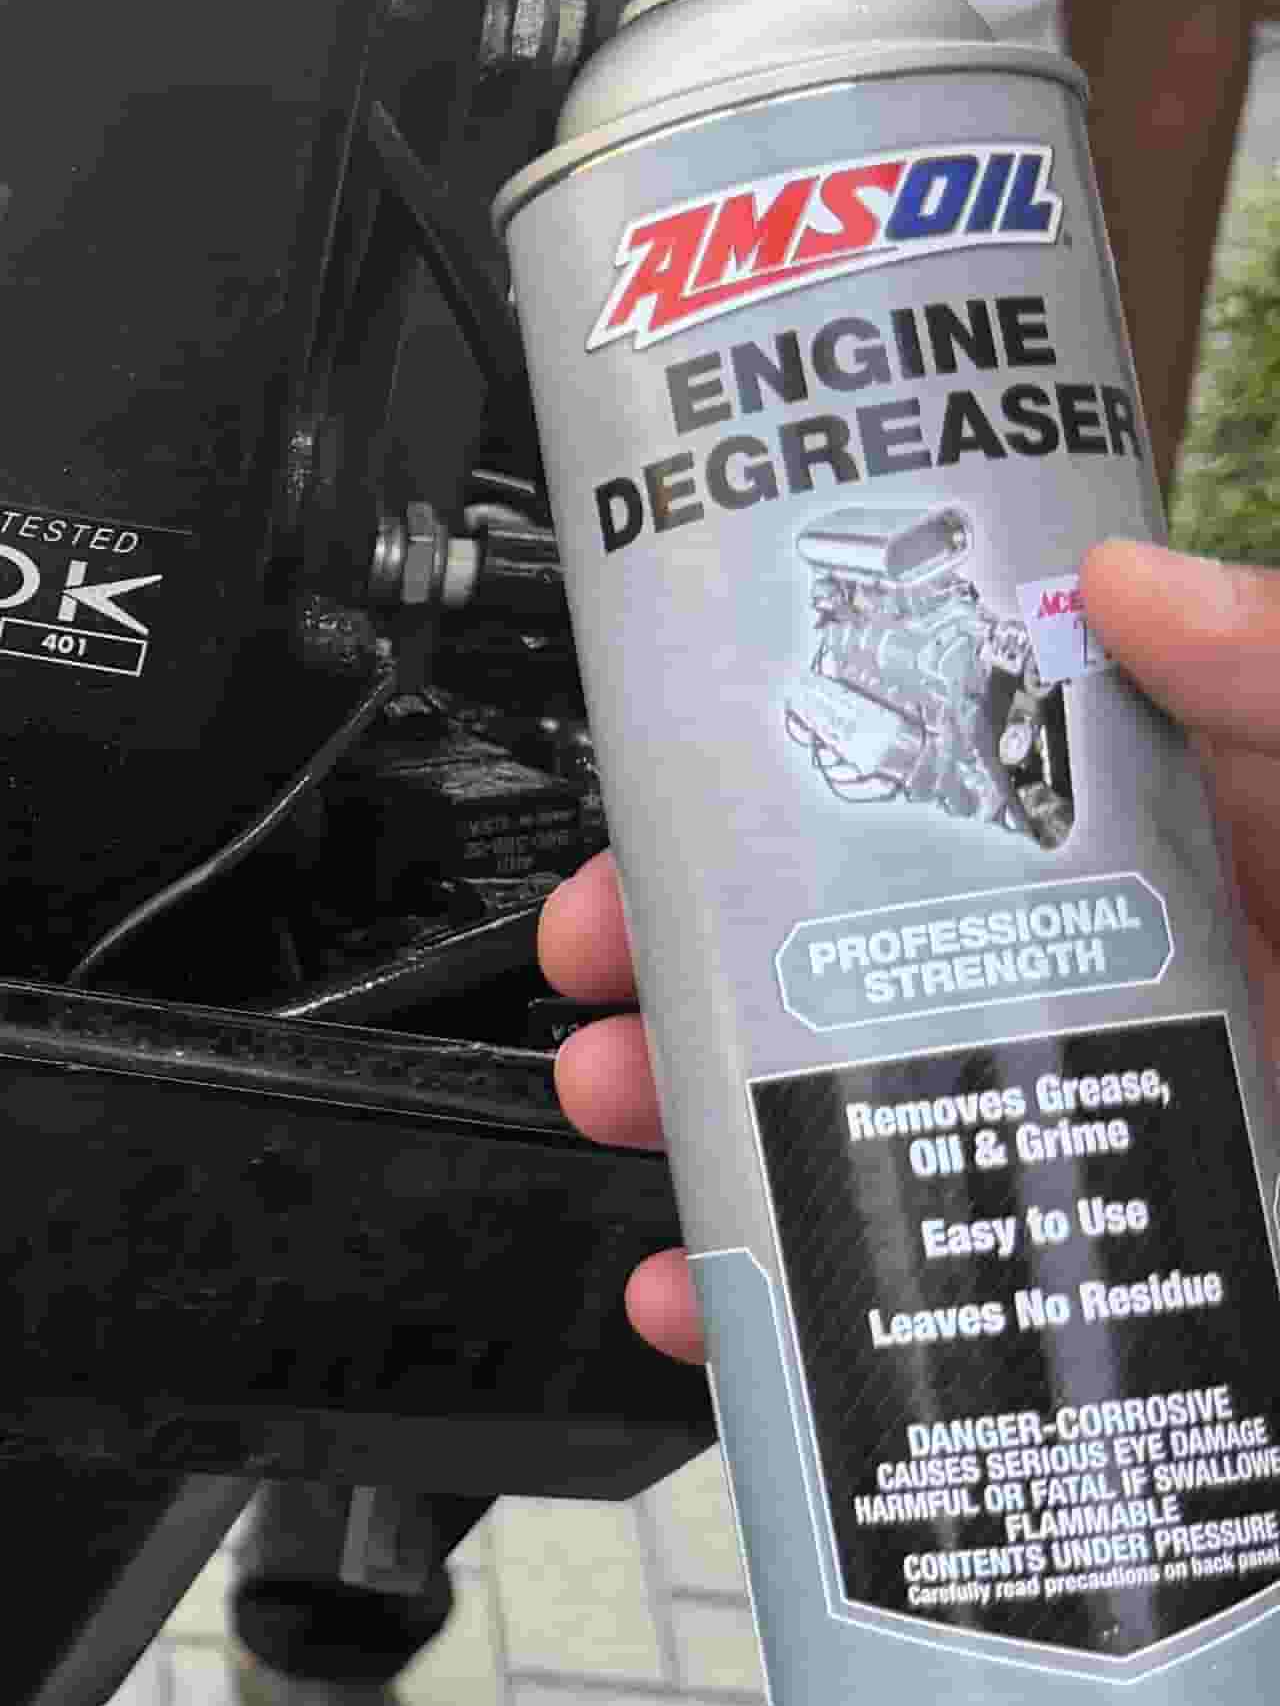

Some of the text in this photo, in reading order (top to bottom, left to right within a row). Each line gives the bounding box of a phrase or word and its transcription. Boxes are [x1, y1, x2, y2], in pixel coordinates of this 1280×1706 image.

[606, 151, 1060, 335] AMSOIL
[665, 296, 1057, 436] ENGINE
[594, 382, 1144, 554] DEGREASER
[40, 631, 89, 658] 401
[807, 893, 1142, 977] PROFESSIONAL
[863, 940, 1107, 1005] STRENGTH
[846, 1068, 1171, 1142] Removes Grease,
[909, 1117, 1130, 1178] Oil & Grime
[920, 1196, 1149, 1262] Easy to Use
[868, 1270, 1223, 1349] Leaves No Residue
[877, 1416, 1269, 1489] CAUSES SERIOUS EYE DAMAGE
[906, 1384, 1233, 1457] DANGER-CORROSIVE
[854, 1488, 981, 1525] HARMFUL
[984, 1483, 1025, 1513] OR
[1031, 1473, 1117, 1509] FATAL
[1121, 1467, 1149, 1498] IF
[1005, 1495, 1181, 1542] FLAMMABLE
[903, 1511, 1279, 1582] CONTENTS UNDER PRESSURE
[995, 1573, 1041, 1598] read
[1044, 1563, 1161, 1595] precautions
[1164, 1561, 1188, 1581] on
